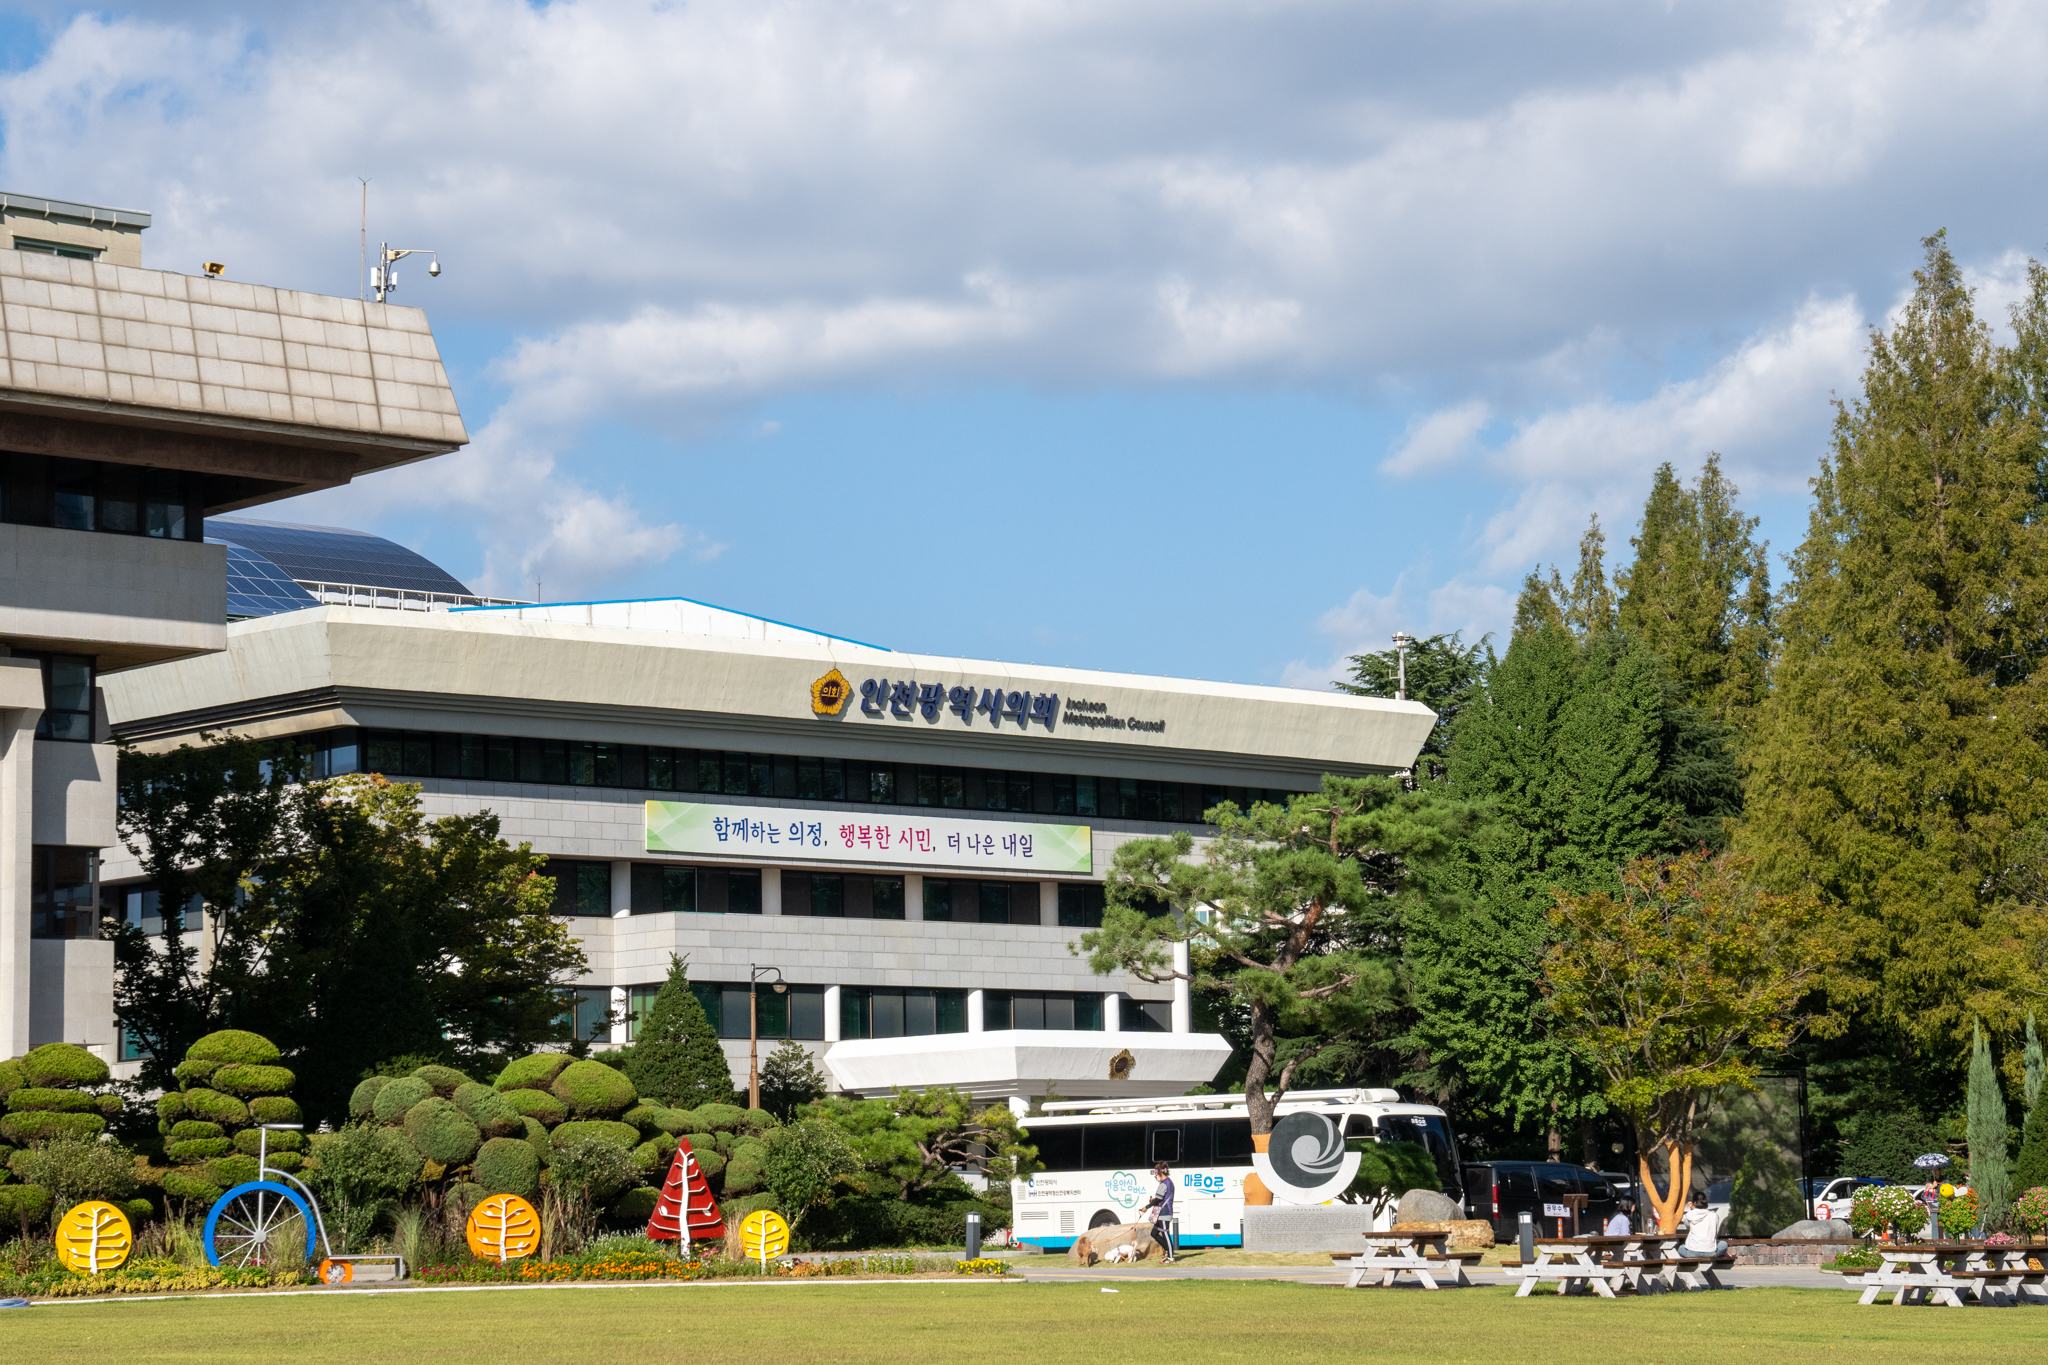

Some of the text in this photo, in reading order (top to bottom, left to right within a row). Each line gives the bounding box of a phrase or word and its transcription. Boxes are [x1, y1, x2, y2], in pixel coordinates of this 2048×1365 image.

[821, 685, 841, 698] 의회
[860, 678, 1057, 727] 인천광역시의회
[1066, 697, 1107, 714] Incheon
[1062, 711, 1166, 733] Metropolitan Council
[713, 817, 1034, 858] 함께하는 의정, 행복한 시민, 더 나은 내일
